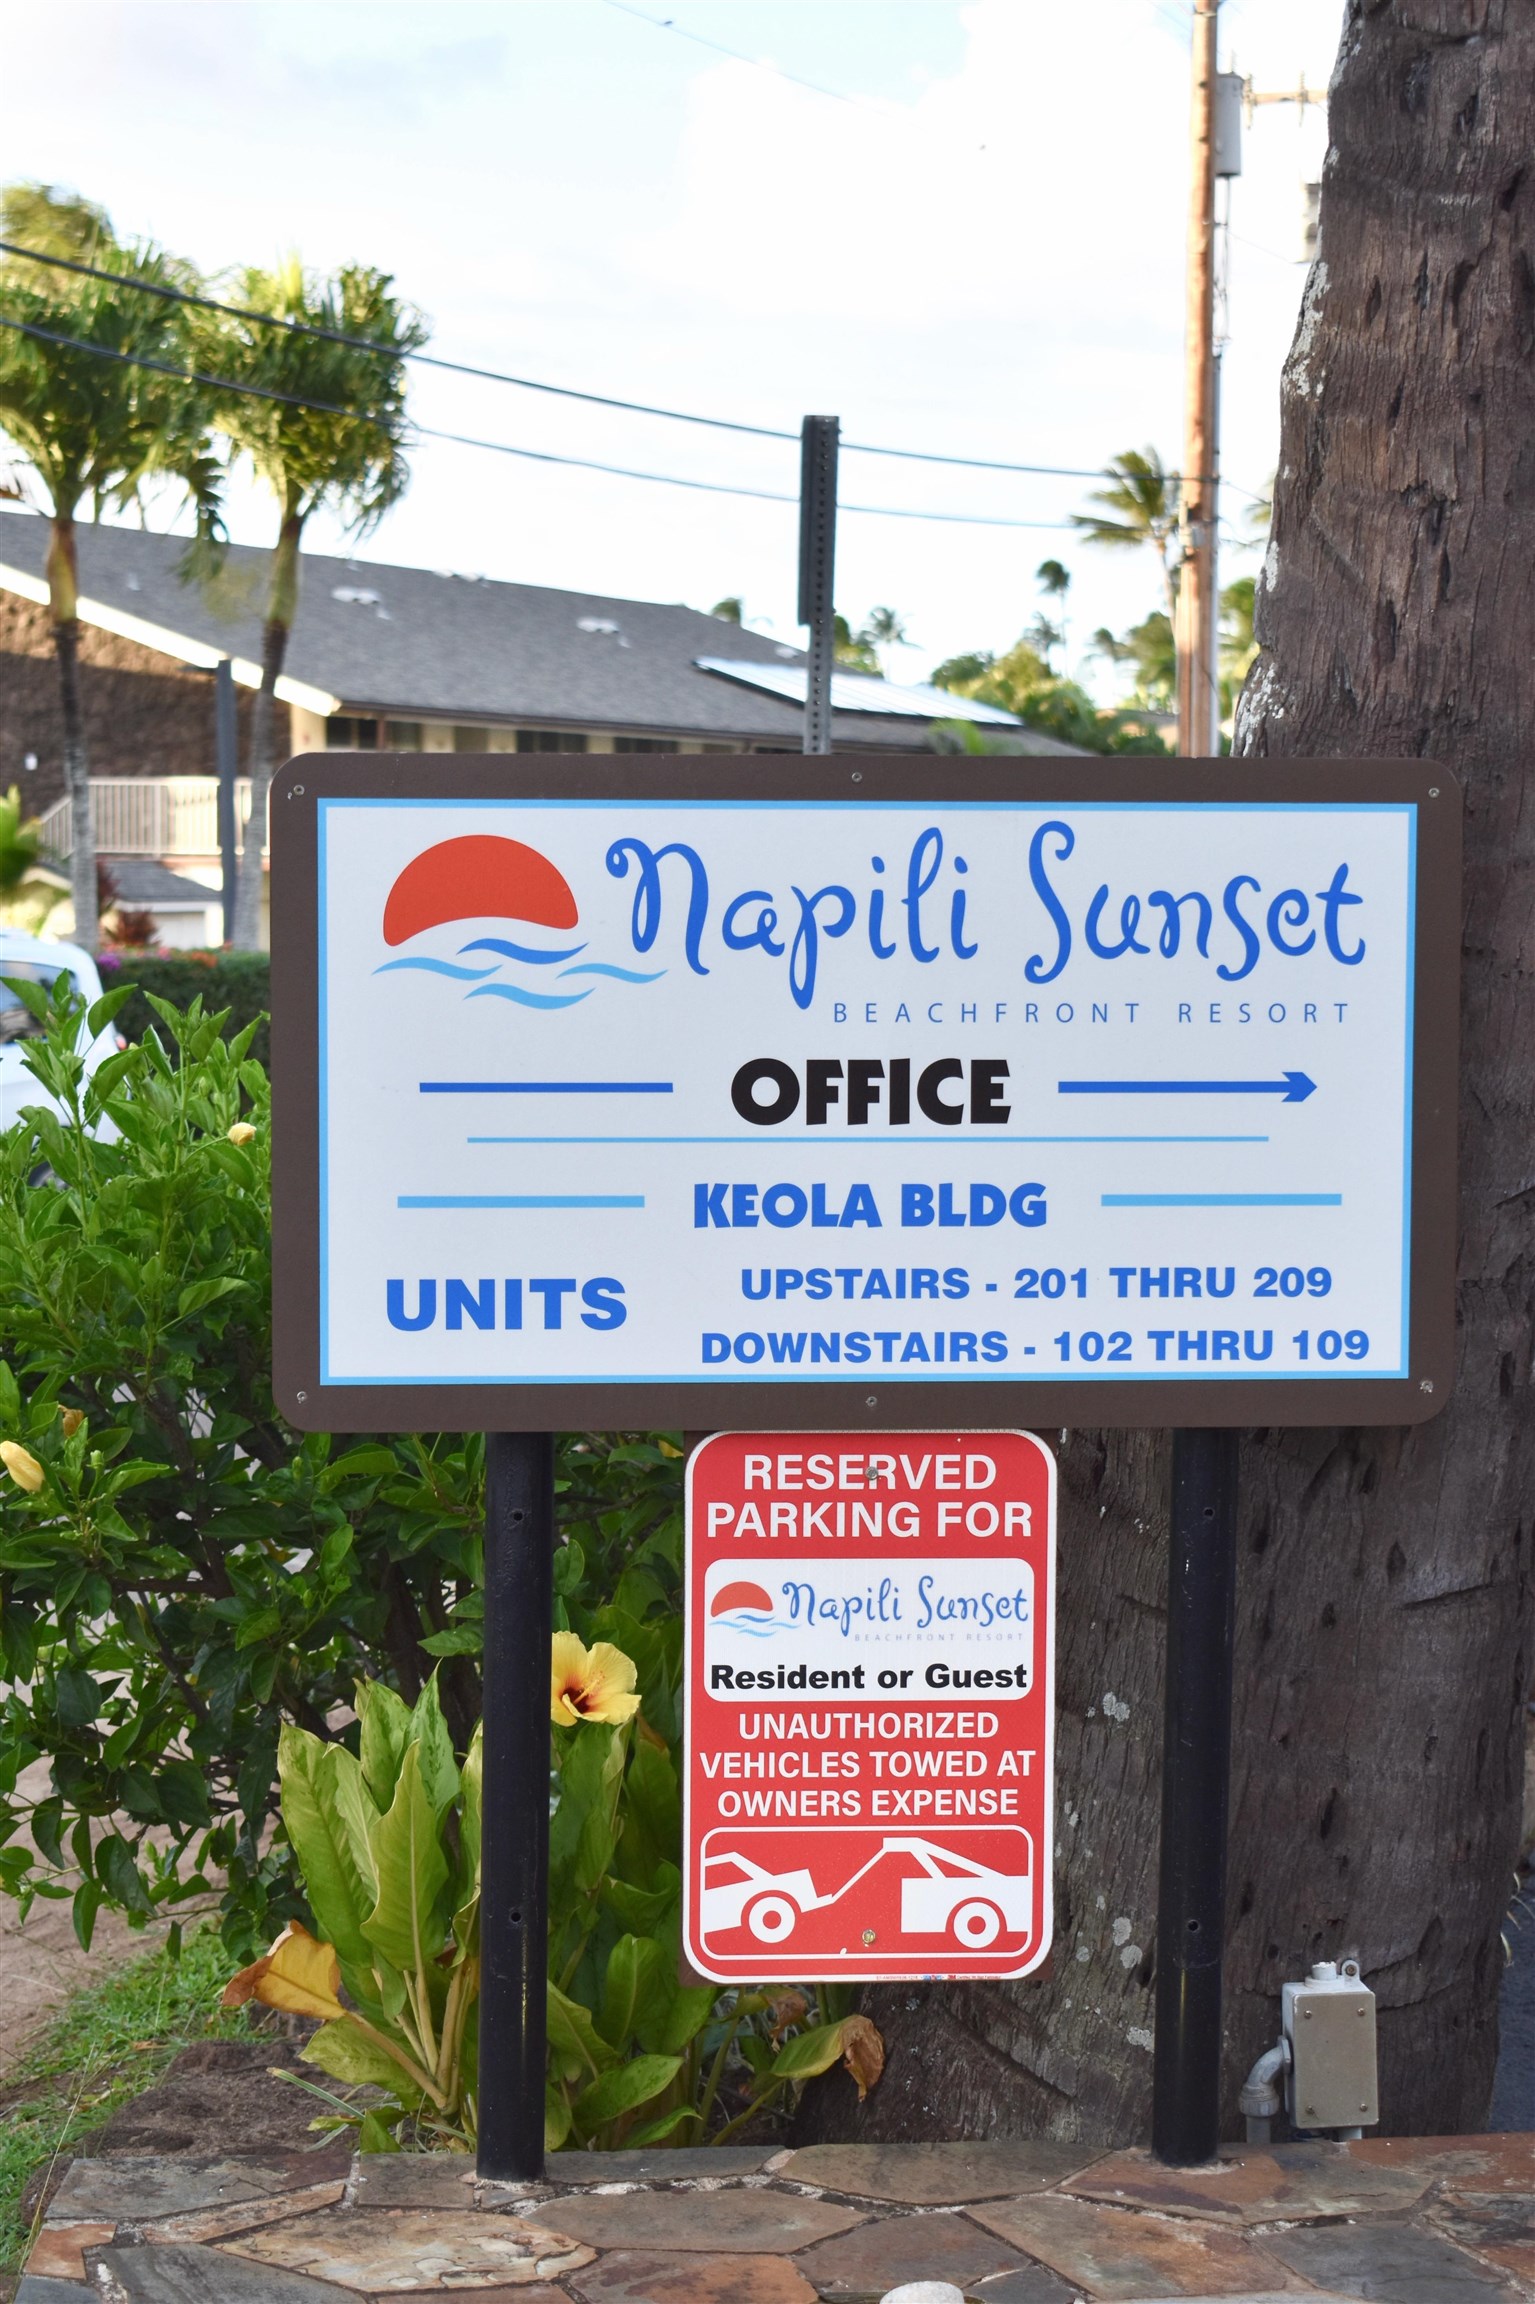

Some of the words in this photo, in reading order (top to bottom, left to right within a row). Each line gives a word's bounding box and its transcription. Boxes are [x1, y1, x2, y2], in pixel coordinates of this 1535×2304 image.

[605, 826, 979, 1011] Napili
[1023, 820, 1367, 985] Sunset
[834, 1002, 1140, 1024] BEACHFRONT
[1178, 1002, 1348, 1024] RESORT
[730, 1057, 1012, 1126] OFFICE
[693, 1182, 883, 1229] KEOLA
[900, 1182, 1048, 1228] BLDG
[741, 1267, 971, 1301] UPSTAIRS
[1013, 1267, 1087, 1300] 201
[1108, 1266, 1236, 1299] THRU
[1252, 1266, 1333, 1298] 209
[386, 1276, 628, 1332] UNITS
[701, 1331, 1009, 1364] DOWNSTAIRS
[1053, 1330, 1133, 1362] 102
[1146, 1329, 1274, 1362] THRU
[1292, 1329, 1370, 1361] 109
[744, 1454, 997, 1490] RESERVED
[707, 1501, 920, 1538] PARKING
[937, 1501, 1032, 1538] FOR
[781, 1577, 903, 1638] Napili
[916, 1575, 1029, 1629] Sunset
[854, 1633, 955, 1642] BEACHFRONT
[966, 1632, 1024, 1641] RESORT
[711, 1664, 865, 1690] Resident
[877, 1670, 914, 1689] or
[925, 1663, 1027, 1689] Guest
[739, 1712, 999, 1740] UNAUTHORIZED
[699, 1751, 860, 1779] VEHICLES
[868, 1750, 988, 1778] TOWED
[996, 1750, 1037, 1777] AT
[717, 1789, 862, 1818] OWNERS
[871, 1788, 1018, 1816] EXPENSE
